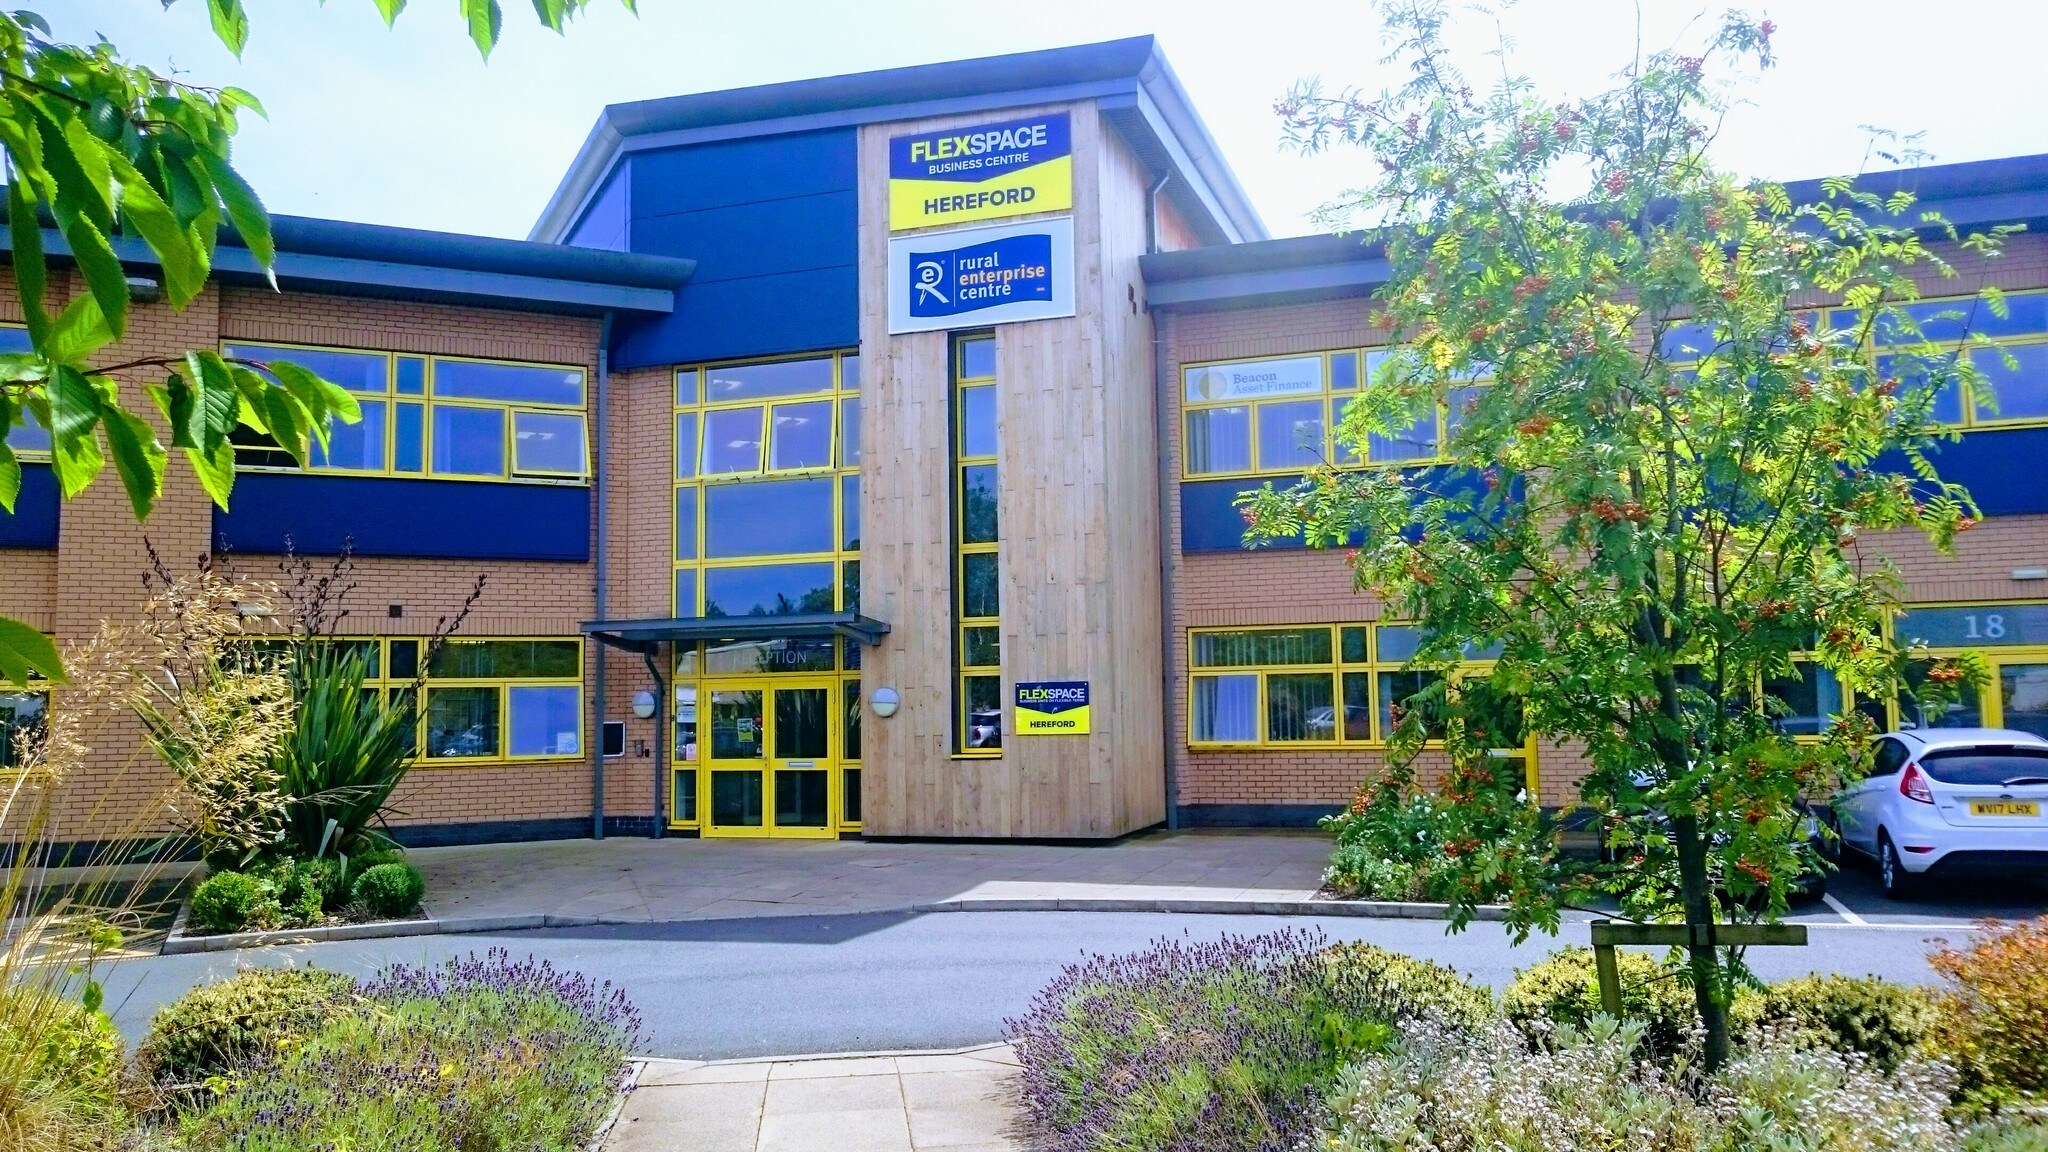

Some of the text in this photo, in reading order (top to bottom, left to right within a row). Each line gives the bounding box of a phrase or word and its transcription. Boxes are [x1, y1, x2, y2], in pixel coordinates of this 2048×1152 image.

[911, 124, 1048, 163] FLEXSPACE
[928, 152, 1030, 175] BUSINESS CENTRE
[924, 186, 1036, 215] HEREFORD
[959, 251, 999, 271] rural
[959, 264, 1046, 286] enterprise
[959, 283, 1012, 300] centre
[1232, 372, 1277, 384] Beacon
[1232, 380, 1312, 395] Asset Finance
[1964, 614, 2006, 638] 18
[1019, 688, 1085, 699] FLEXSPACE
[1030, 720, 1075, 728] HEREFORD
[1977, 804, 2033, 815] WV17 LHX
